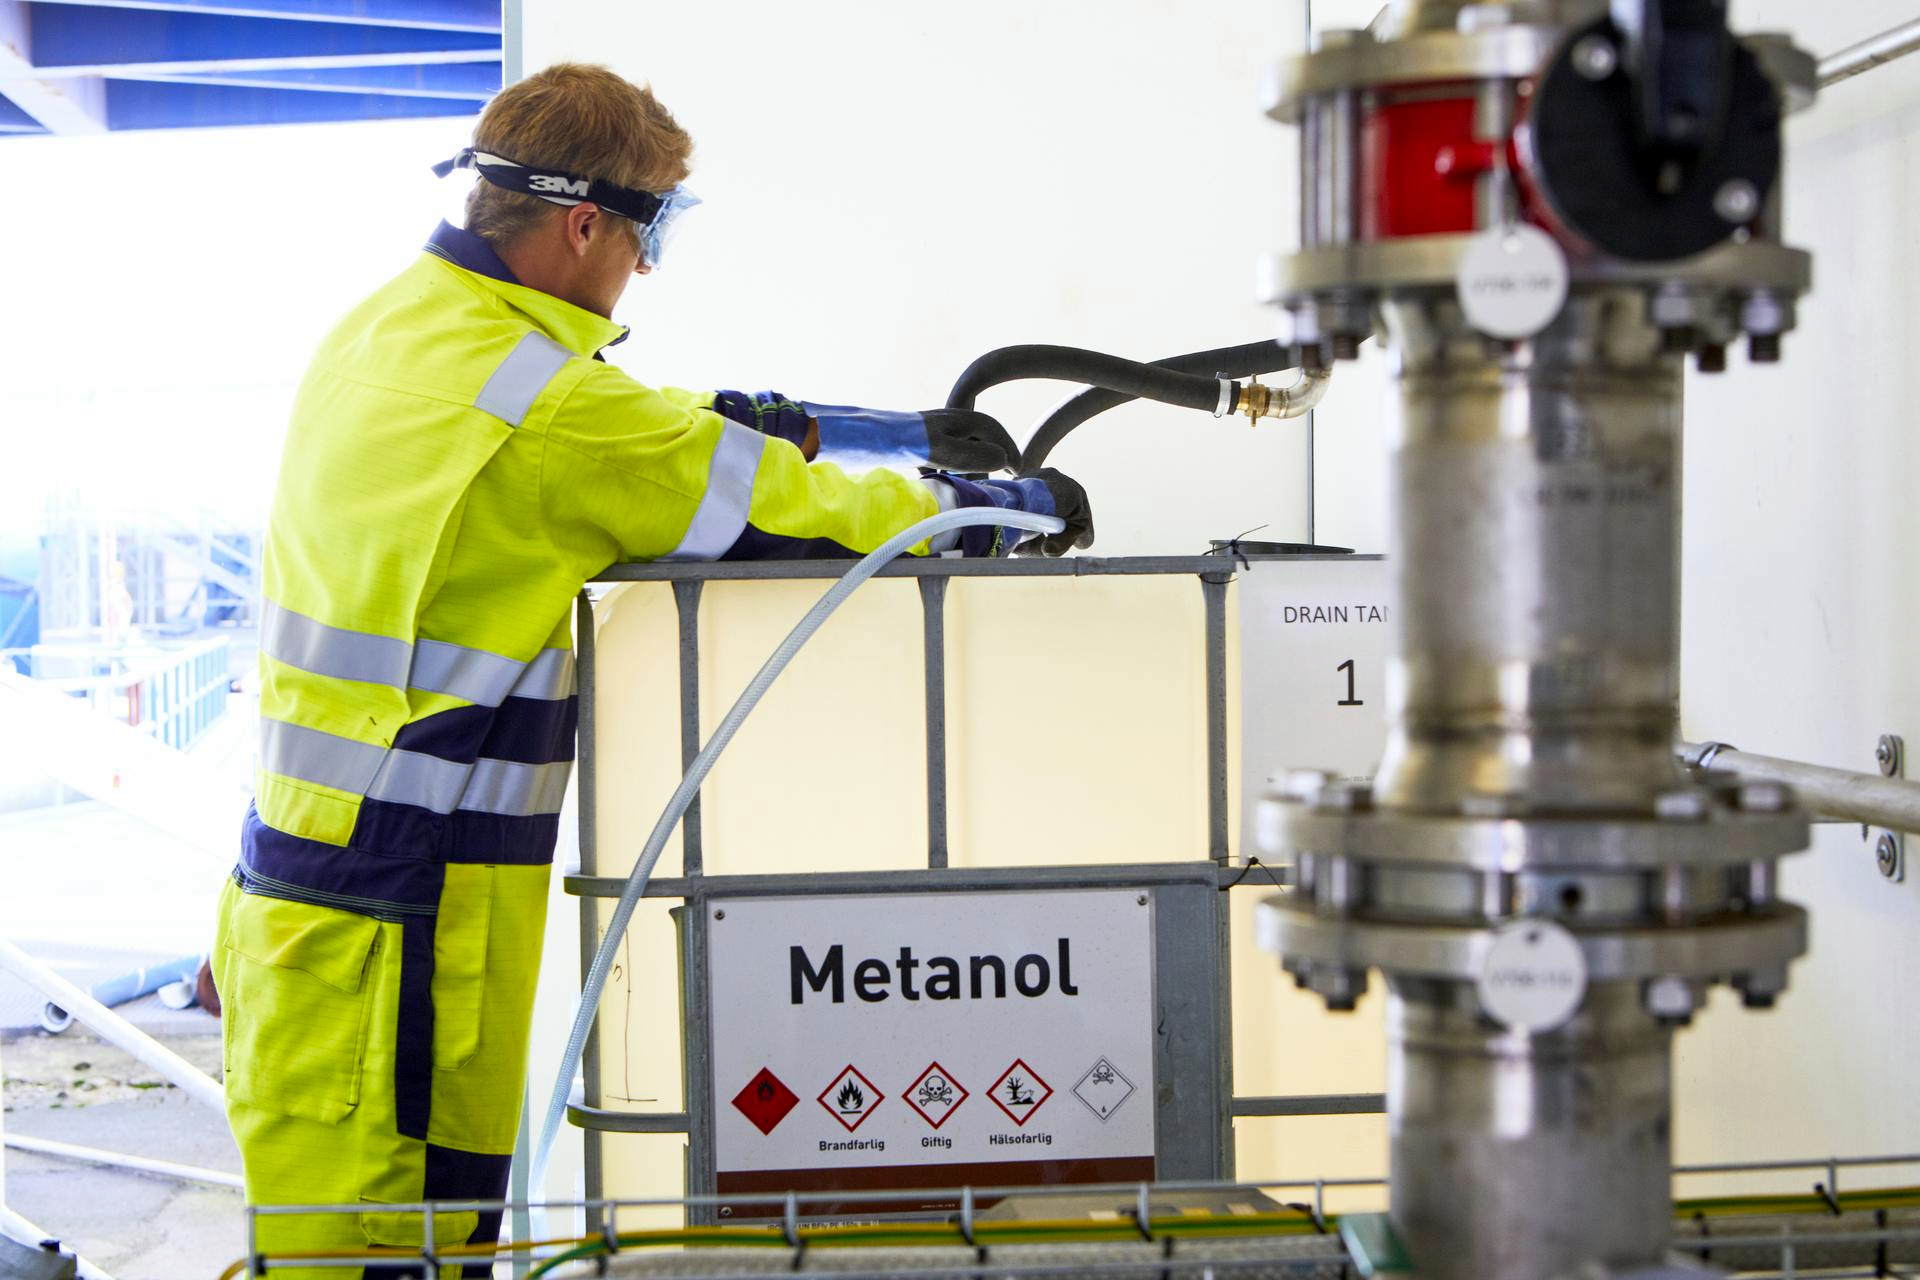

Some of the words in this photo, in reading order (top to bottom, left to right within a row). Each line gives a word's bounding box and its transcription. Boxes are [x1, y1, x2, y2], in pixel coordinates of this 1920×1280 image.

[528, 174, 590, 198] 3M
[1283, 605, 1349, 624] DRAIN
[1337, 659, 1364, 706] 1
[789, 938, 1079, 1005] Metanol
[818, 1139, 885, 1151] Brandfarlig
[921, 1136, 952, 1149] Giftig
[989, 1133, 1053, 1146] Hälsofarlig
